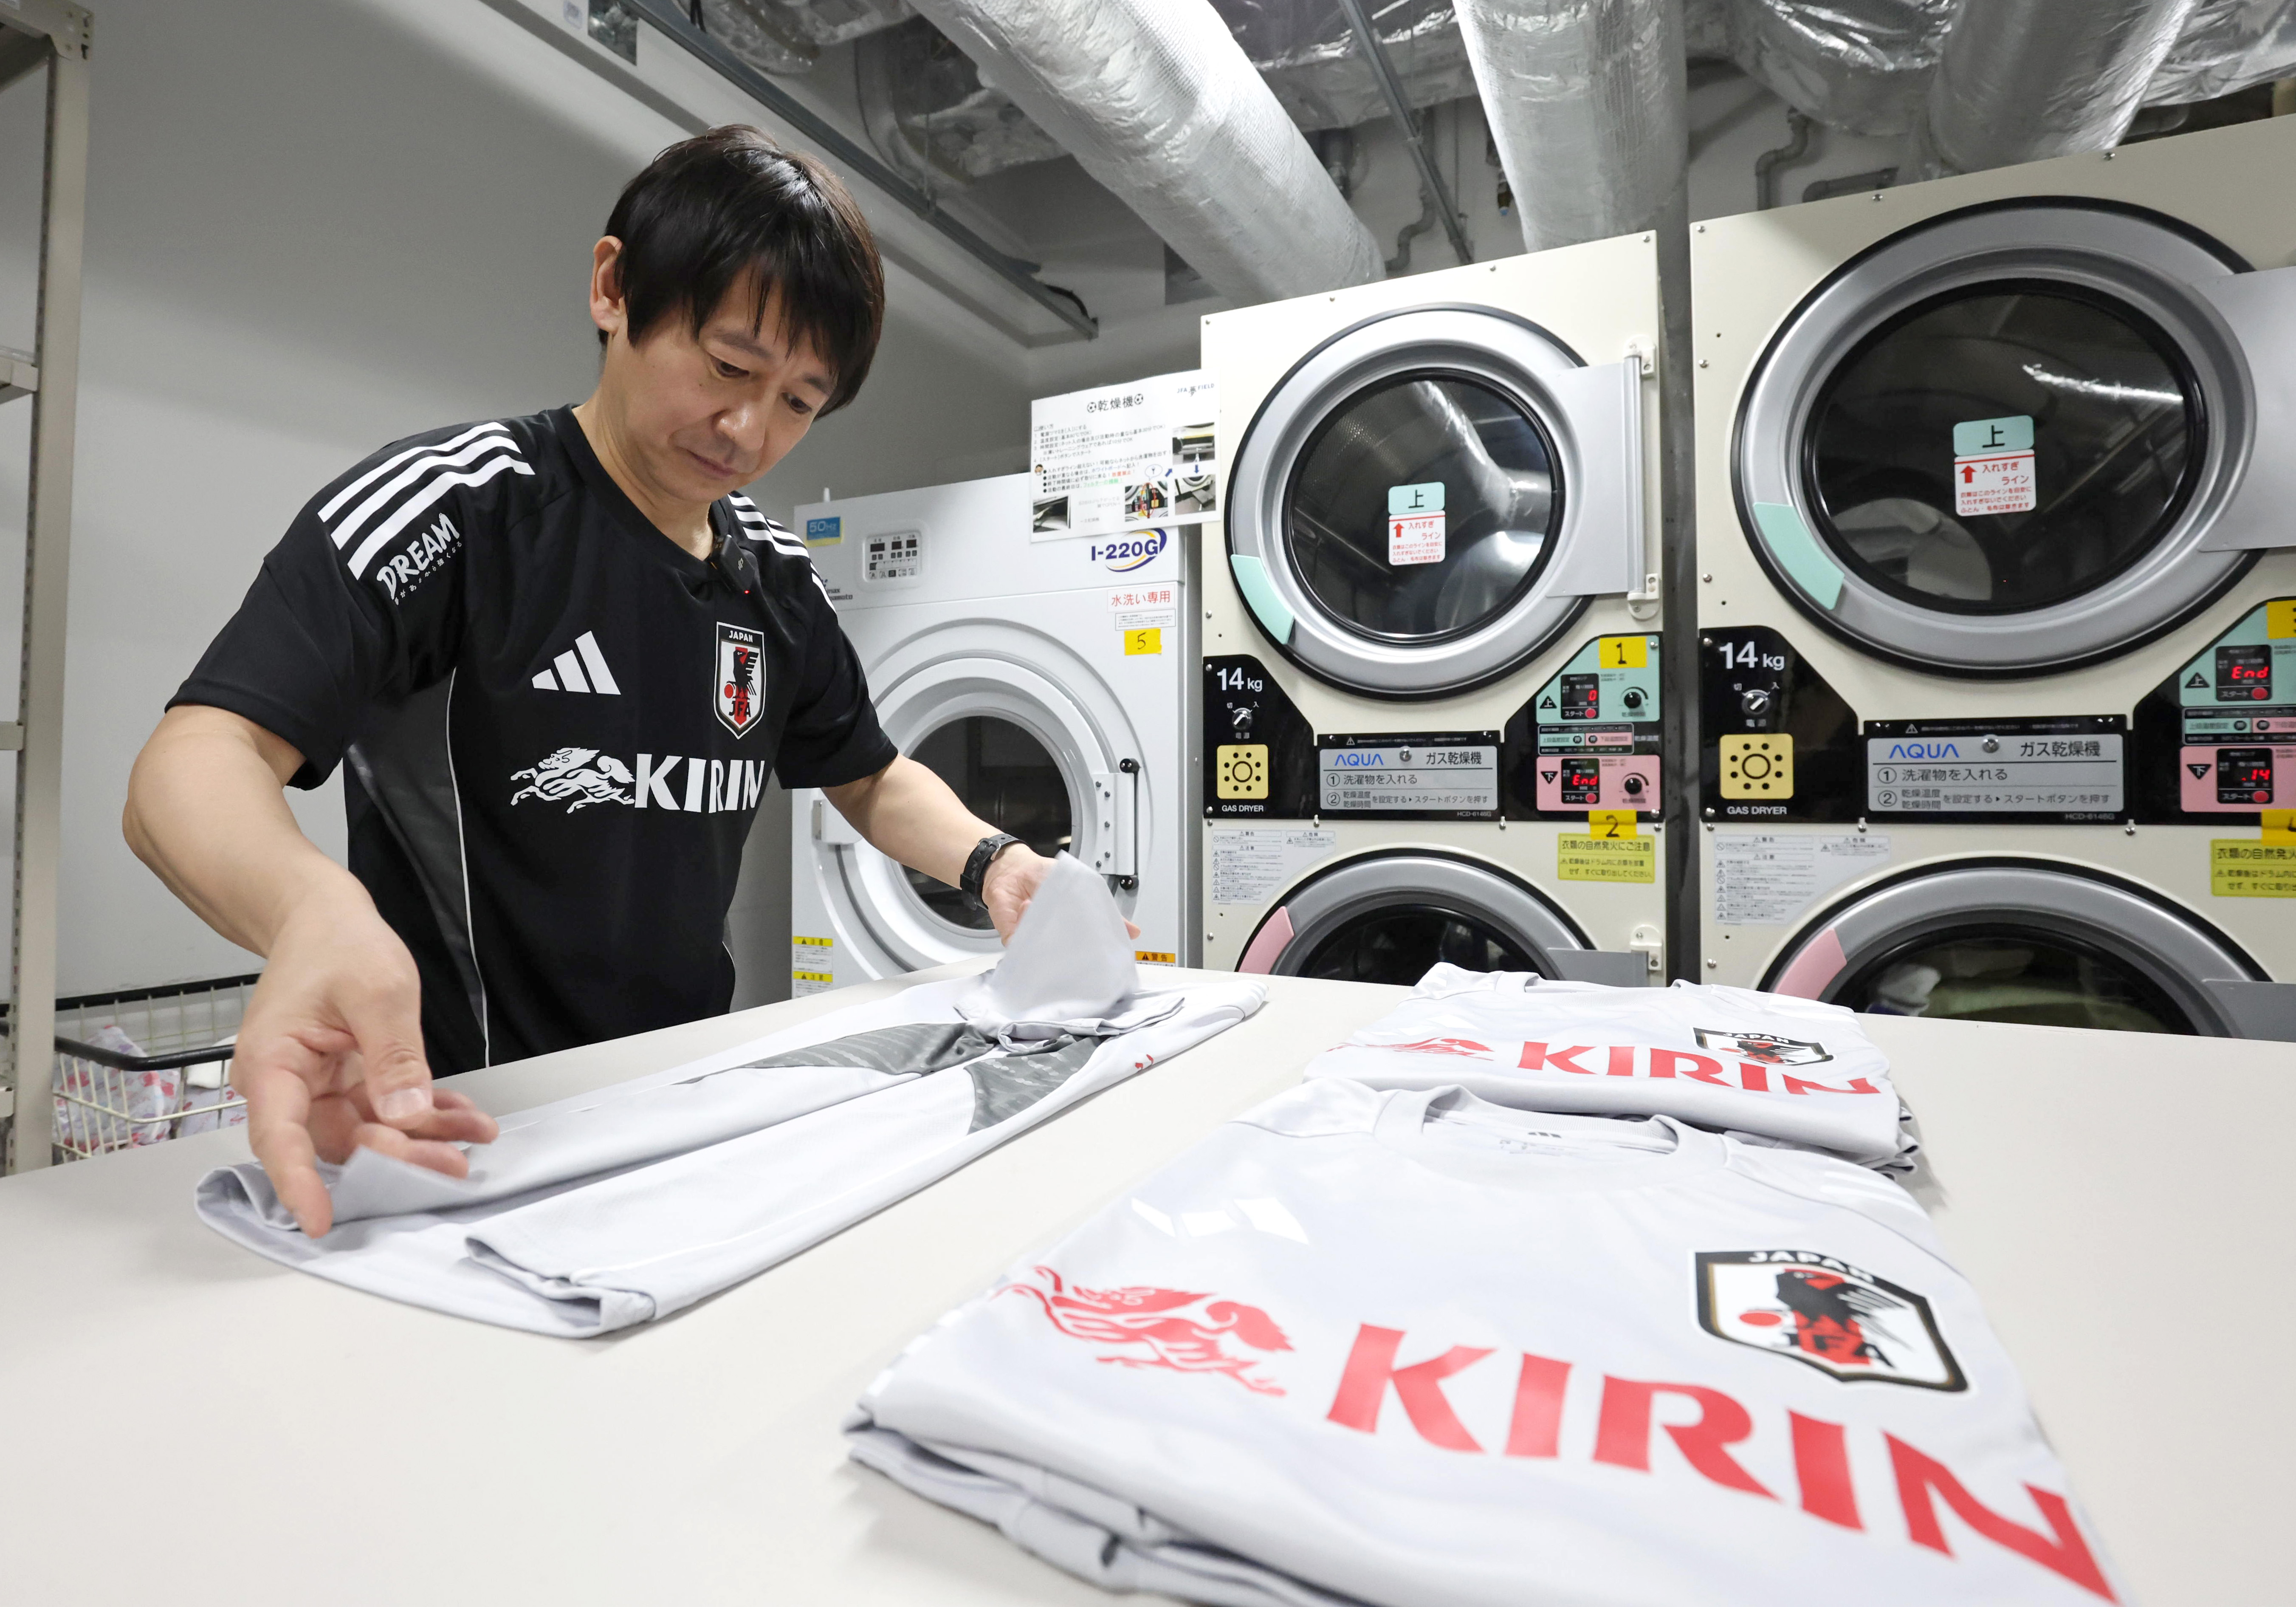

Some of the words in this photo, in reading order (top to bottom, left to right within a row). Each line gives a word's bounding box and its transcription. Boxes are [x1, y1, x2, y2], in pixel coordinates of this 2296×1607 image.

[1097, 395, 1134, 412] 乾燥機
[1983, 425, 2005, 448] 上
[1983, 461, 2019, 473] 入れすぎ
[2002, 475, 2029, 485] ライン
[1408, 489, 1424, 508] 上
[1408, 521, 1434, 530] 入れすぎ
[1422, 532, 1441, 540] ライン
[377, 513, 460, 600] DREAM
[1092, 539, 1158, 561] I-220G
[1111, 590, 1171, 607] 水洗い専用
[729, 630, 753, 643] JAPAN
[1137, 632, 1146, 650] 5
[1616, 642, 1627, 664] 1
[1719, 642, 1758, 669] 14
[1763, 654, 1784, 670] kg
[1217, 667, 1244, 690] 14
[1247, 678, 1262, 692] kg
[2231, 666, 2269, 679] End
[2191, 676, 2203, 686] 上
[728, 700, 751, 717] JFA
[1544, 699, 1553, 707] 上
[1889, 744, 1959, 759] AQUA
[2020, 741, 2101, 757] ガス乾燥機
[1334, 754, 1384, 766] AQUA
[1426, 751, 1482, 765] ガス乾燥機
[1545, 772, 1554, 782] 下
[1902, 768, 2008, 782] 洗濯物を入れる
[2193, 765, 2206, 776] 下
[634, 753, 765, 813] KIRIN
[1343, 774, 1417, 785] 洗濯物を入れる
[1572, 774, 1598, 786] End
[1415, 795, 1488, 804] スタートボタンを押す
[2005, 794, 2110, 804] スタートボタンを押す
[1727, 806, 1749, 815] GAS
[1751, 806, 1787, 815] DRYER
[1606, 814, 1620, 837] 2
[1562, 840, 1650, 851] 衣類の自然発火にご注意
[1723, 1030, 1789, 1046] JAPAN
[1518, 1042, 1880, 1095] KIRIN
[1749, 1251, 1876, 1284] JAPAN
[1326, 1323, 2121, 1604] KIRIN
